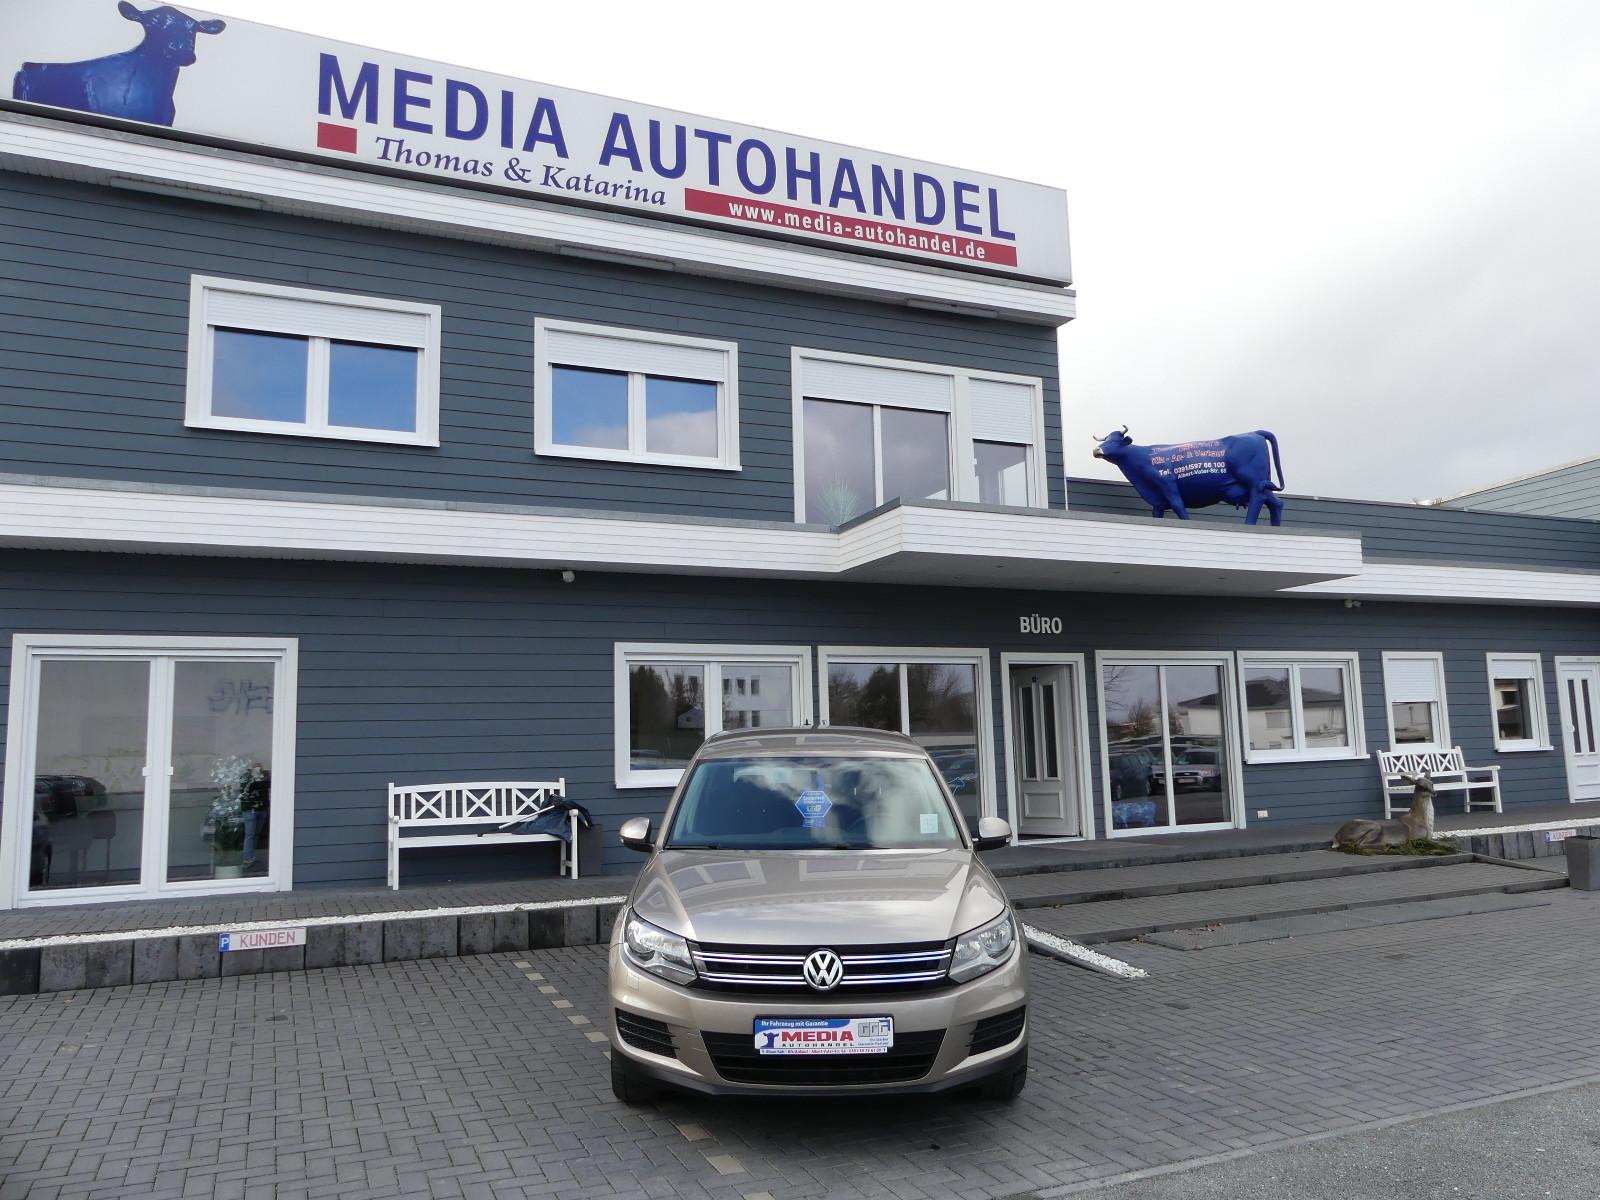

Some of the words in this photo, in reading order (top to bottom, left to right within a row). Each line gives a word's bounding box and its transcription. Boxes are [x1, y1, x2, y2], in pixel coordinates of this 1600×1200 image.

[318, 53, 570, 160] MEDIA
[598, 112, 1016, 241] AUTOHANDEL
[375, 135, 494, 177] Thomas
[503, 157, 531, 184] &
[540, 164, 666, 206] Katarina
[728, 201, 986, 259] www.media-autohandel.de
[1019, 613, 1063, 634] BÜRO
[221, 937, 229, 948] P
[239, 931, 296, 948] KUNDEN
[769, 1020, 795, 1028] Fahrzeug
[781, 1030, 854, 1042] MEDIA
